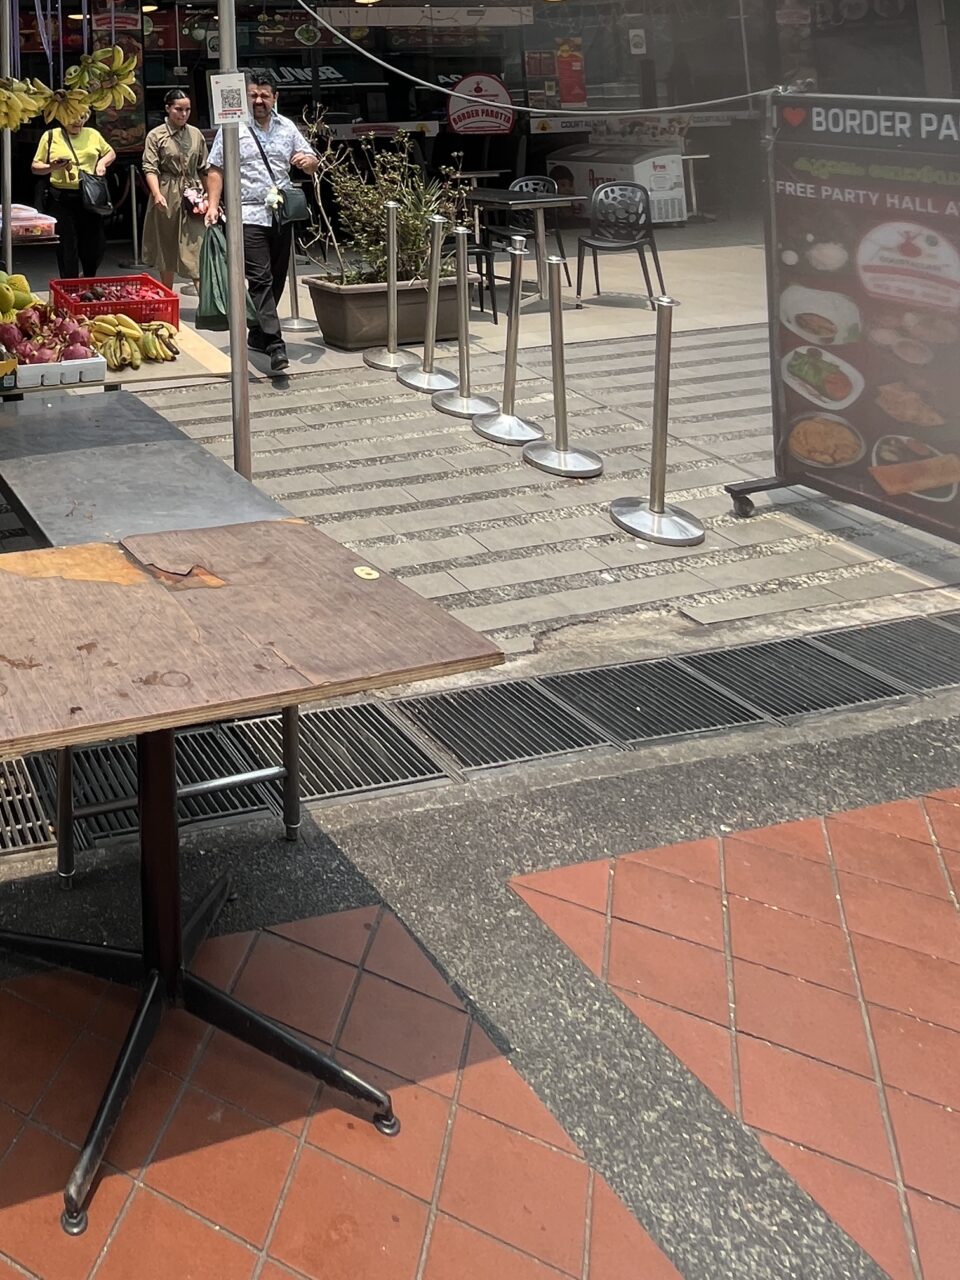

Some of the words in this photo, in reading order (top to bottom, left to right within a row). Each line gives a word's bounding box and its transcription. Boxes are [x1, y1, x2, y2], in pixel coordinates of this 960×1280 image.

[452, 108, 480, 126] BORDER
[481, 108, 512, 124] PAROTTA
[812, 107, 912, 138] BORDER
[920, 113, 960, 142] PA
[775, 180, 816, 199] FREE
[821, 185, 881, 206] PARTY
[886, 195, 939, 214] HALL
[944, 203, 960, 217] A
